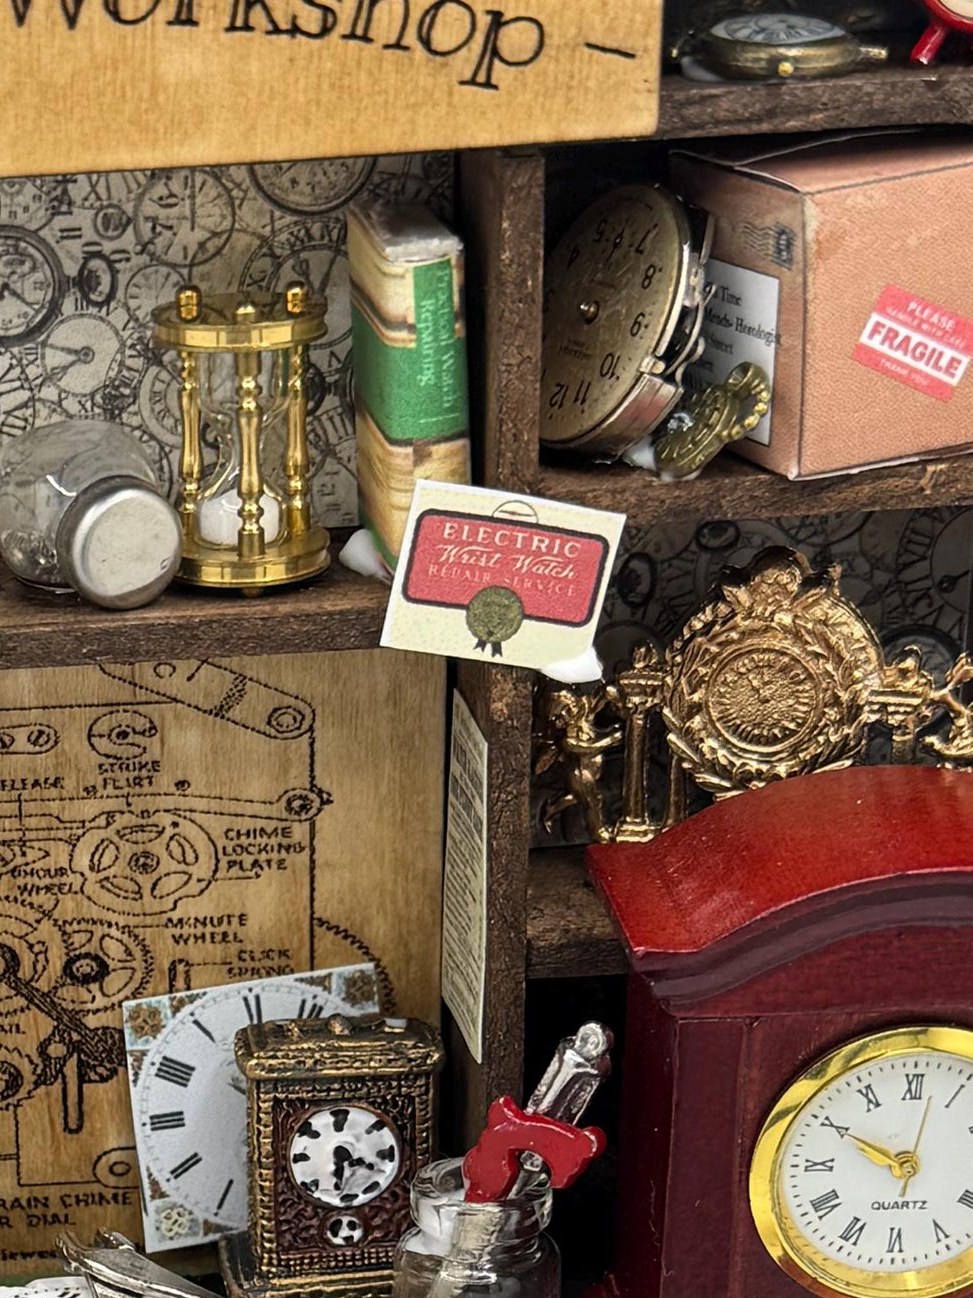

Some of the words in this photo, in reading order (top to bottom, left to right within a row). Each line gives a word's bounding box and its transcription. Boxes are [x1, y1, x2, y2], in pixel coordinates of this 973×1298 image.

[641, 264, 657, 290] 8
[630, 312, 645, 338] 9
[907, 300, 956, 333] PLEASE
[416, 300, 436, 387] Repairing
[867, 320, 963, 380] FRAGILE
[599, 352, 622, 381] 10
[549, 383, 570, 410] 12
[443, 523, 582, 559] ELECTRIC
[428, 564, 492, 584] REPAIR
[435, 544, 503, 568] Wrist
[512, 554, 578, 580] Watch
[98, 761, 161, 775] STRIKE
[224, 826, 293, 840] CHIME
[222, 841, 306, 856] LOCKING
[227, 858, 288, 872] PLATE
[166, 914, 248, 928] MINUTE
[172, 931, 243, 945] WHEEL
[856, 1084, 882, 1113] XI
[901, 1073, 926, 1100] XII
[945, 1084, 966, 1108] I
[820, 1116, 850, 1139] X
[804, 1157, 835, 1173] IX
[58, 1192, 132, 1209] CHIME
[810, 1189, 842, 1220] VIII
[871, 1200, 930, 1211] QUARTZ
[26, 1213, 77, 1229] DIAL
[838, 1217, 867, 1246] VII
[932, 1219, 951, 1243] V
[886, 1226, 904, 1253] VI
